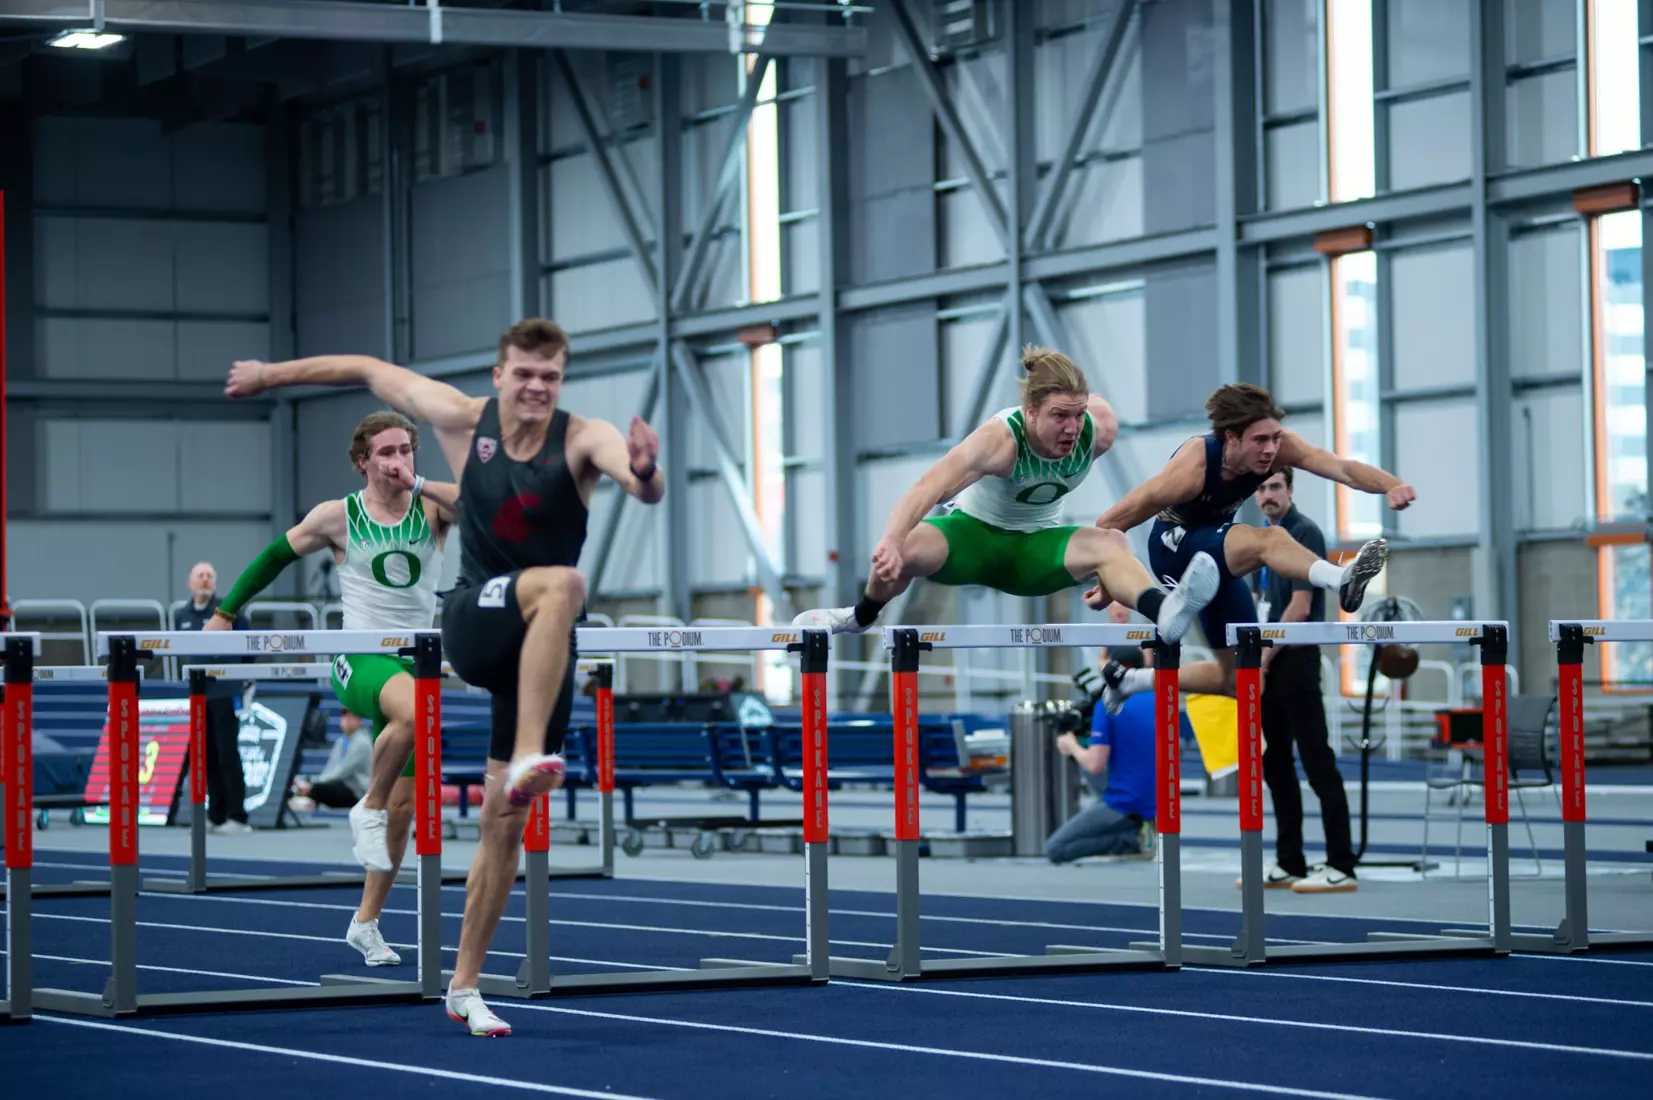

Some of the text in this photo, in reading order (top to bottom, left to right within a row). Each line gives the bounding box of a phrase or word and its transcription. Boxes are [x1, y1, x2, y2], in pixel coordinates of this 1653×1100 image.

[1016, 482, 1069, 505] O
[371, 550, 421, 588] O
[771, 633, 797, 643] GILL
[920, 632, 946, 642] GILL
[1010, 629, 1023, 643] THE
[1126, 630, 1150, 640] GILL
[1262, 629, 1287, 639] GILL
[1346, 626, 1359, 640] THE
[1455, 627, 1479, 636] GILL
[1583, 626, 1606, 635] GILL
[140, 639, 170, 649] GILL
[245, 635, 261, 650] THE
[380, 637, 409, 647] GILL
[648, 632, 661, 647] THE
[1249, 683, 1258, 817] SPOKANE
[1495, 680, 1503, 810] SPOKANE
[1572, 678, 1580, 807] SPOKANE
[814, 689, 822, 828] SPOKANE
[906, 688, 914, 824] SPOKANE
[1167, 685, 1175, 819] SPOKANE
[121, 699, 129, 848] SPOKANE
[427, 694, 436, 840] SPOKANE
[17, 701, 25, 851] SPOKANE
